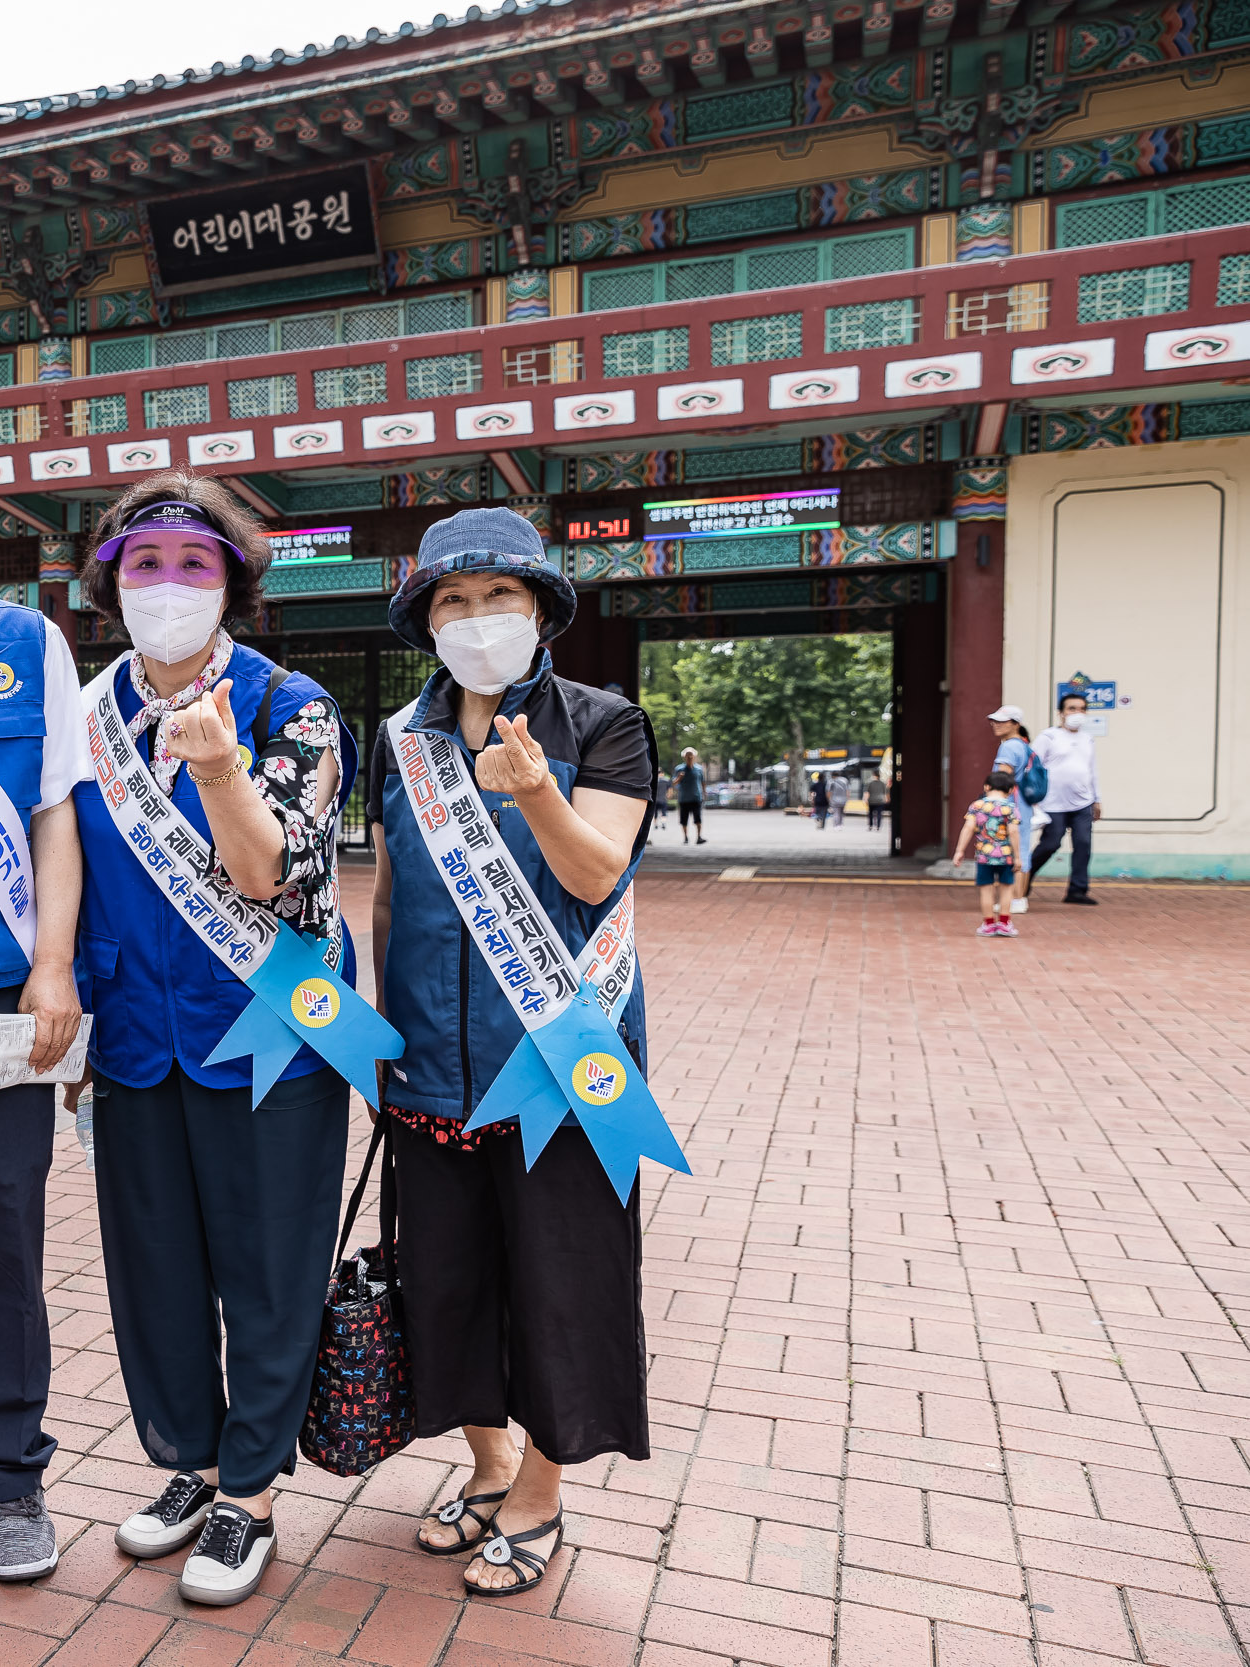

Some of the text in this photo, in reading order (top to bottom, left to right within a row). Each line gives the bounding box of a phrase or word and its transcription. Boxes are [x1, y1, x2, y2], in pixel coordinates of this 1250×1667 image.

[173, 190, 353, 256] 어린이대공원
[98, 692, 131, 768] 여름철
[127, 769, 168, 822] 행락
[1085, 688, 1114, 702] 216
[9, 874, 29, 919] 운동
[129, 821, 254, 965] 방역수칙준수
[399, 734, 547, 1013] 코로나19 방역수칙준수
[451, 795, 491, 850] 행락
[481, 858, 579, 1000] 질서지키기
